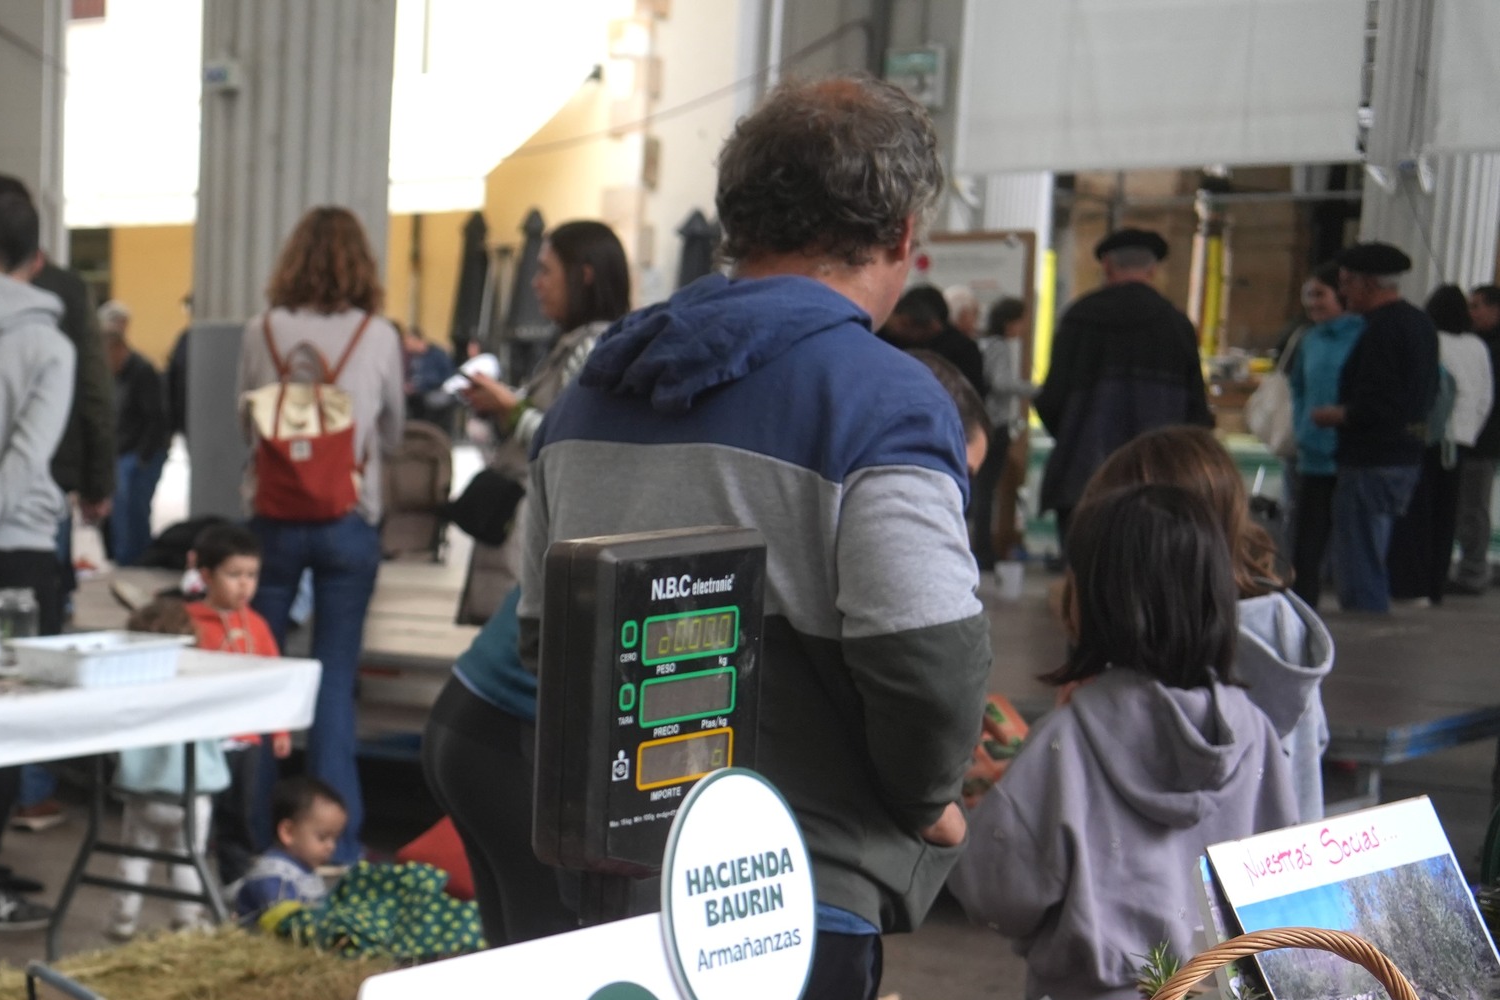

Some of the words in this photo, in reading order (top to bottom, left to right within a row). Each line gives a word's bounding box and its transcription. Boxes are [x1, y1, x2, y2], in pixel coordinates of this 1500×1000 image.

[692, 574, 733, 595] electronic
[620, 652, 638, 663] CERO
[656, 663, 676, 675] PESO
[718, 656, 728, 667] kg
[618, 716, 634, 726] TARA
[653, 724, 680, 738] PRECIO
[650, 787, 682, 801] IMPORTE
[685, 848, 794, 896] HACIENDA
[1243, 843, 1312, 887] Nuestras
[705, 883, 784, 927] BAURIN
[698, 928, 802, 972] Armañanzas
